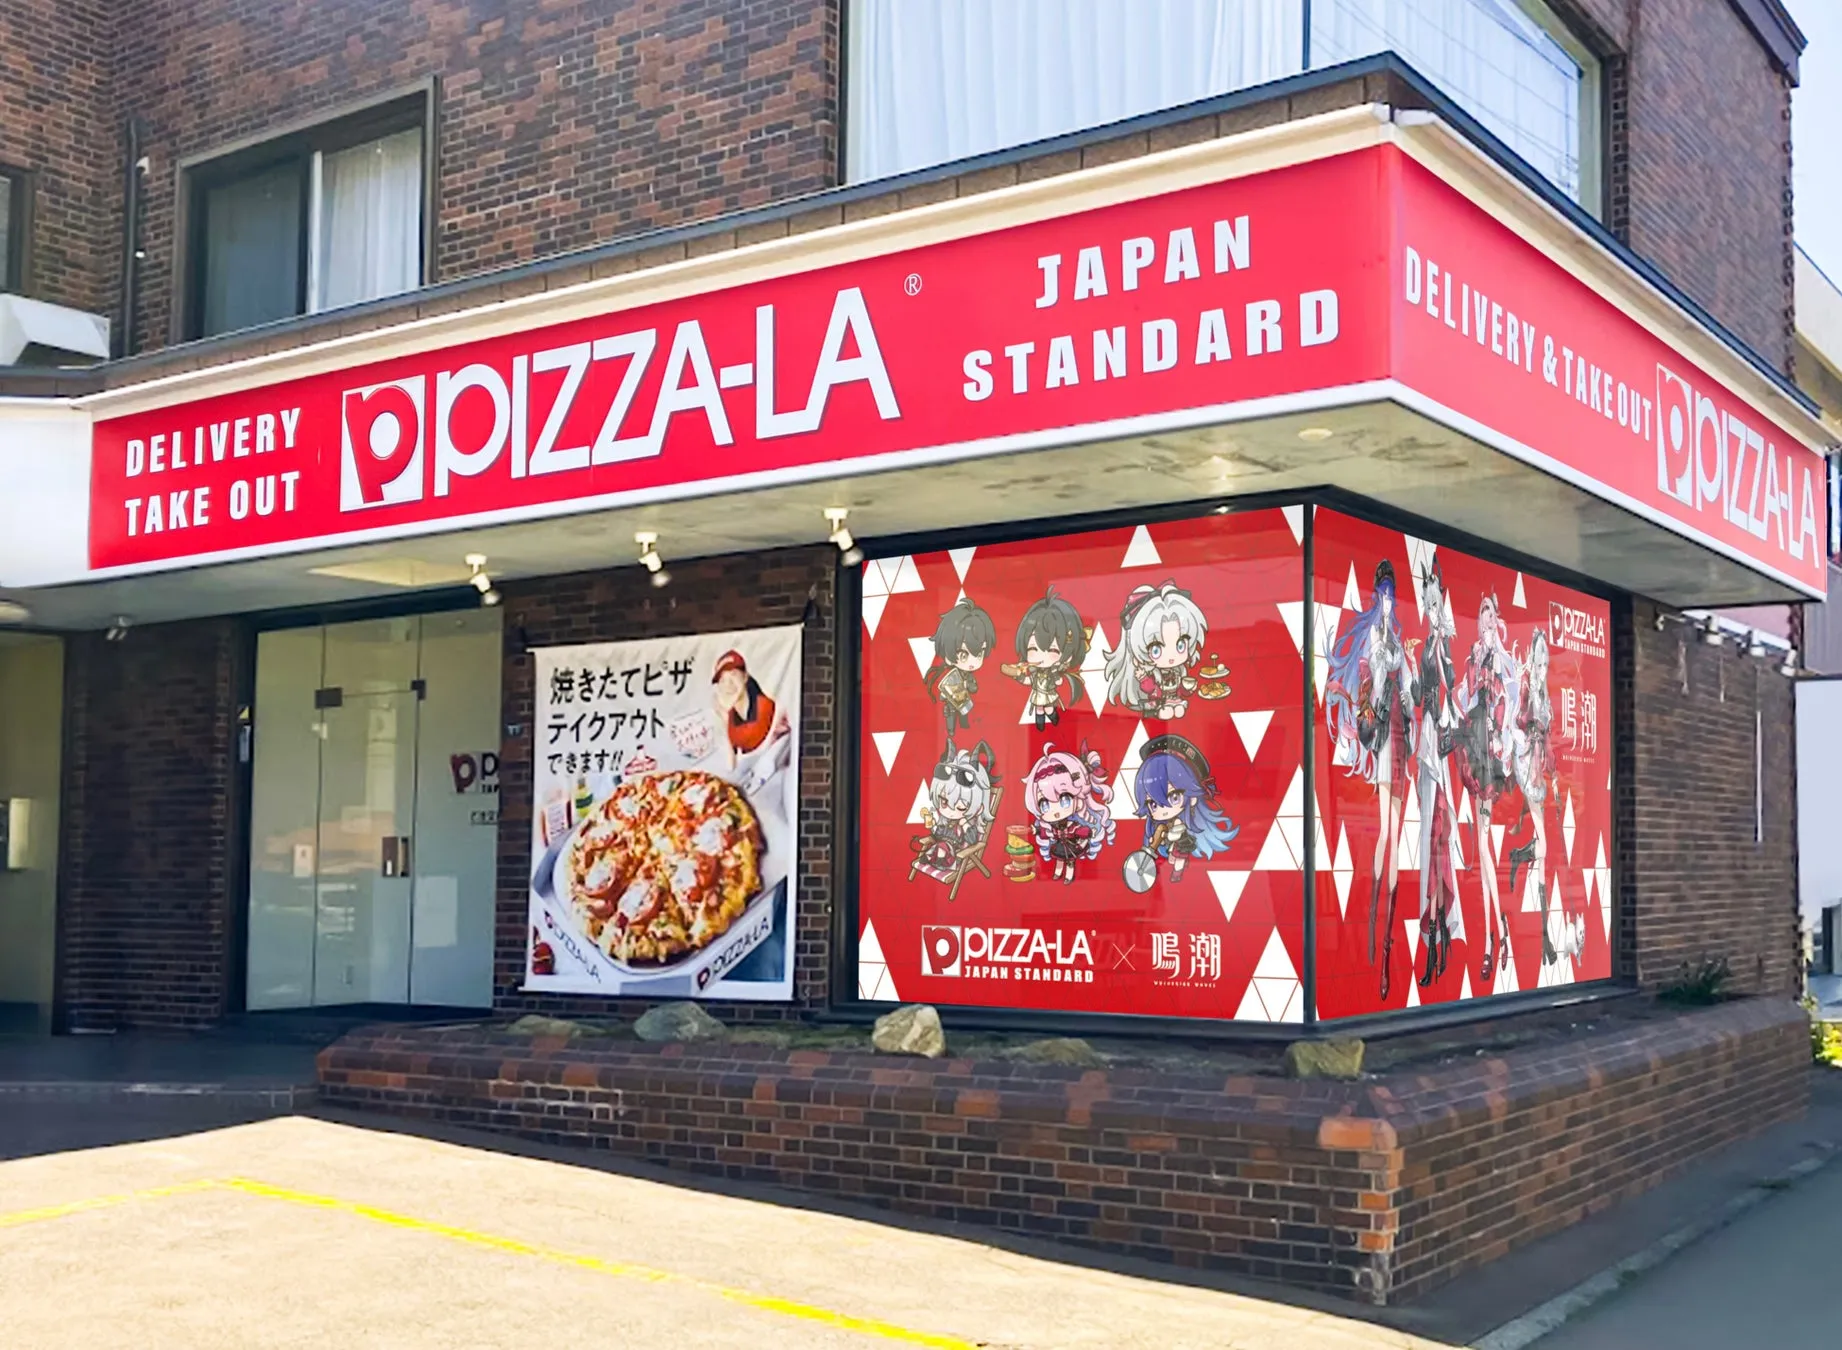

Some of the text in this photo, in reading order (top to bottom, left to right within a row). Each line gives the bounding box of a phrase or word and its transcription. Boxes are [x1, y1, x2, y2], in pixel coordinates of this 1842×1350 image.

[1036, 215, 1251, 309] JAPAN
[963, 289, 1340, 402] STANDARD
[1406, 245, 1652, 441] DELIVERY & TAKE OUT
[126, 407, 301, 477] DELIVERY
[125, 470, 300, 537] TAKE OUT
[550, 657, 695, 705] 焼きたてピザ
[547, 708, 665, 745] テイクアウト
[964, 965, 1094, 983] JAPAN STANDARD
